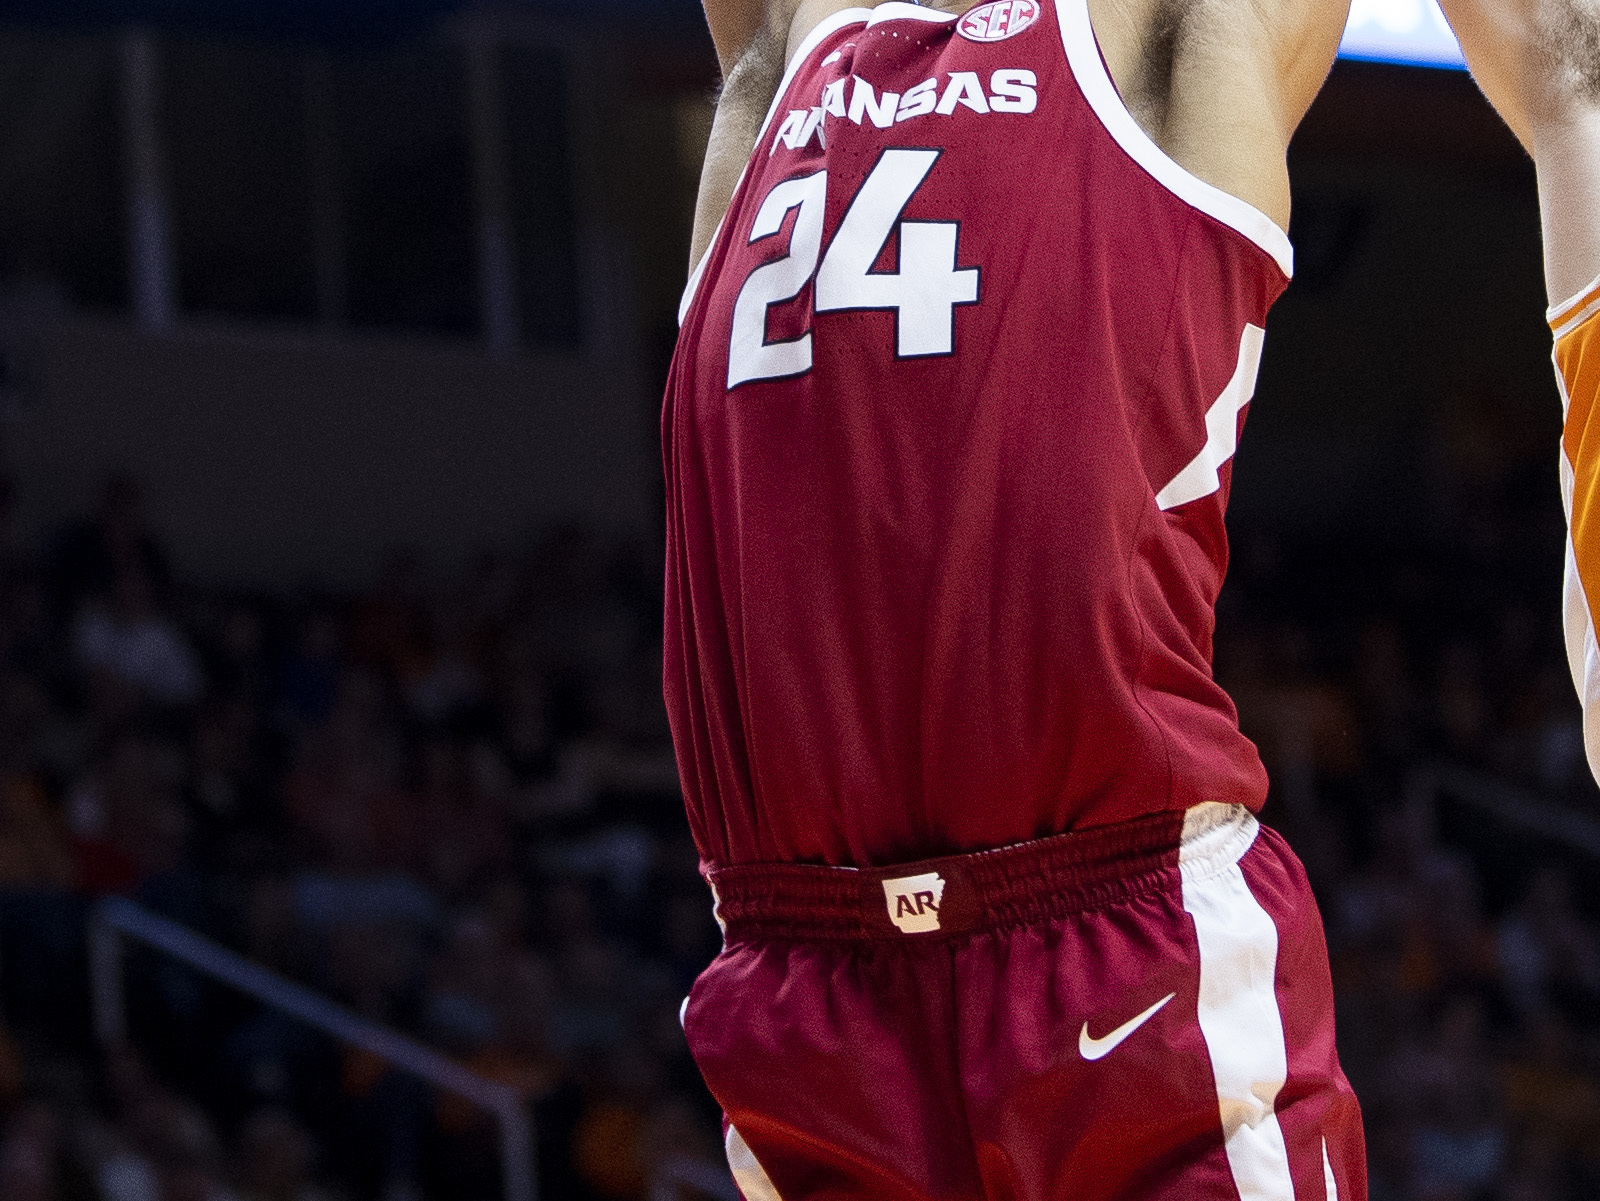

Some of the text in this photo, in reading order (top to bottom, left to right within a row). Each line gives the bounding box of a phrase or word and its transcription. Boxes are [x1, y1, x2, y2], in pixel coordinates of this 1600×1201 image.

[961, 0, 1035, 39] SEC
[727, 146, 982, 391] 24
[895, 890, 940, 918] AR
